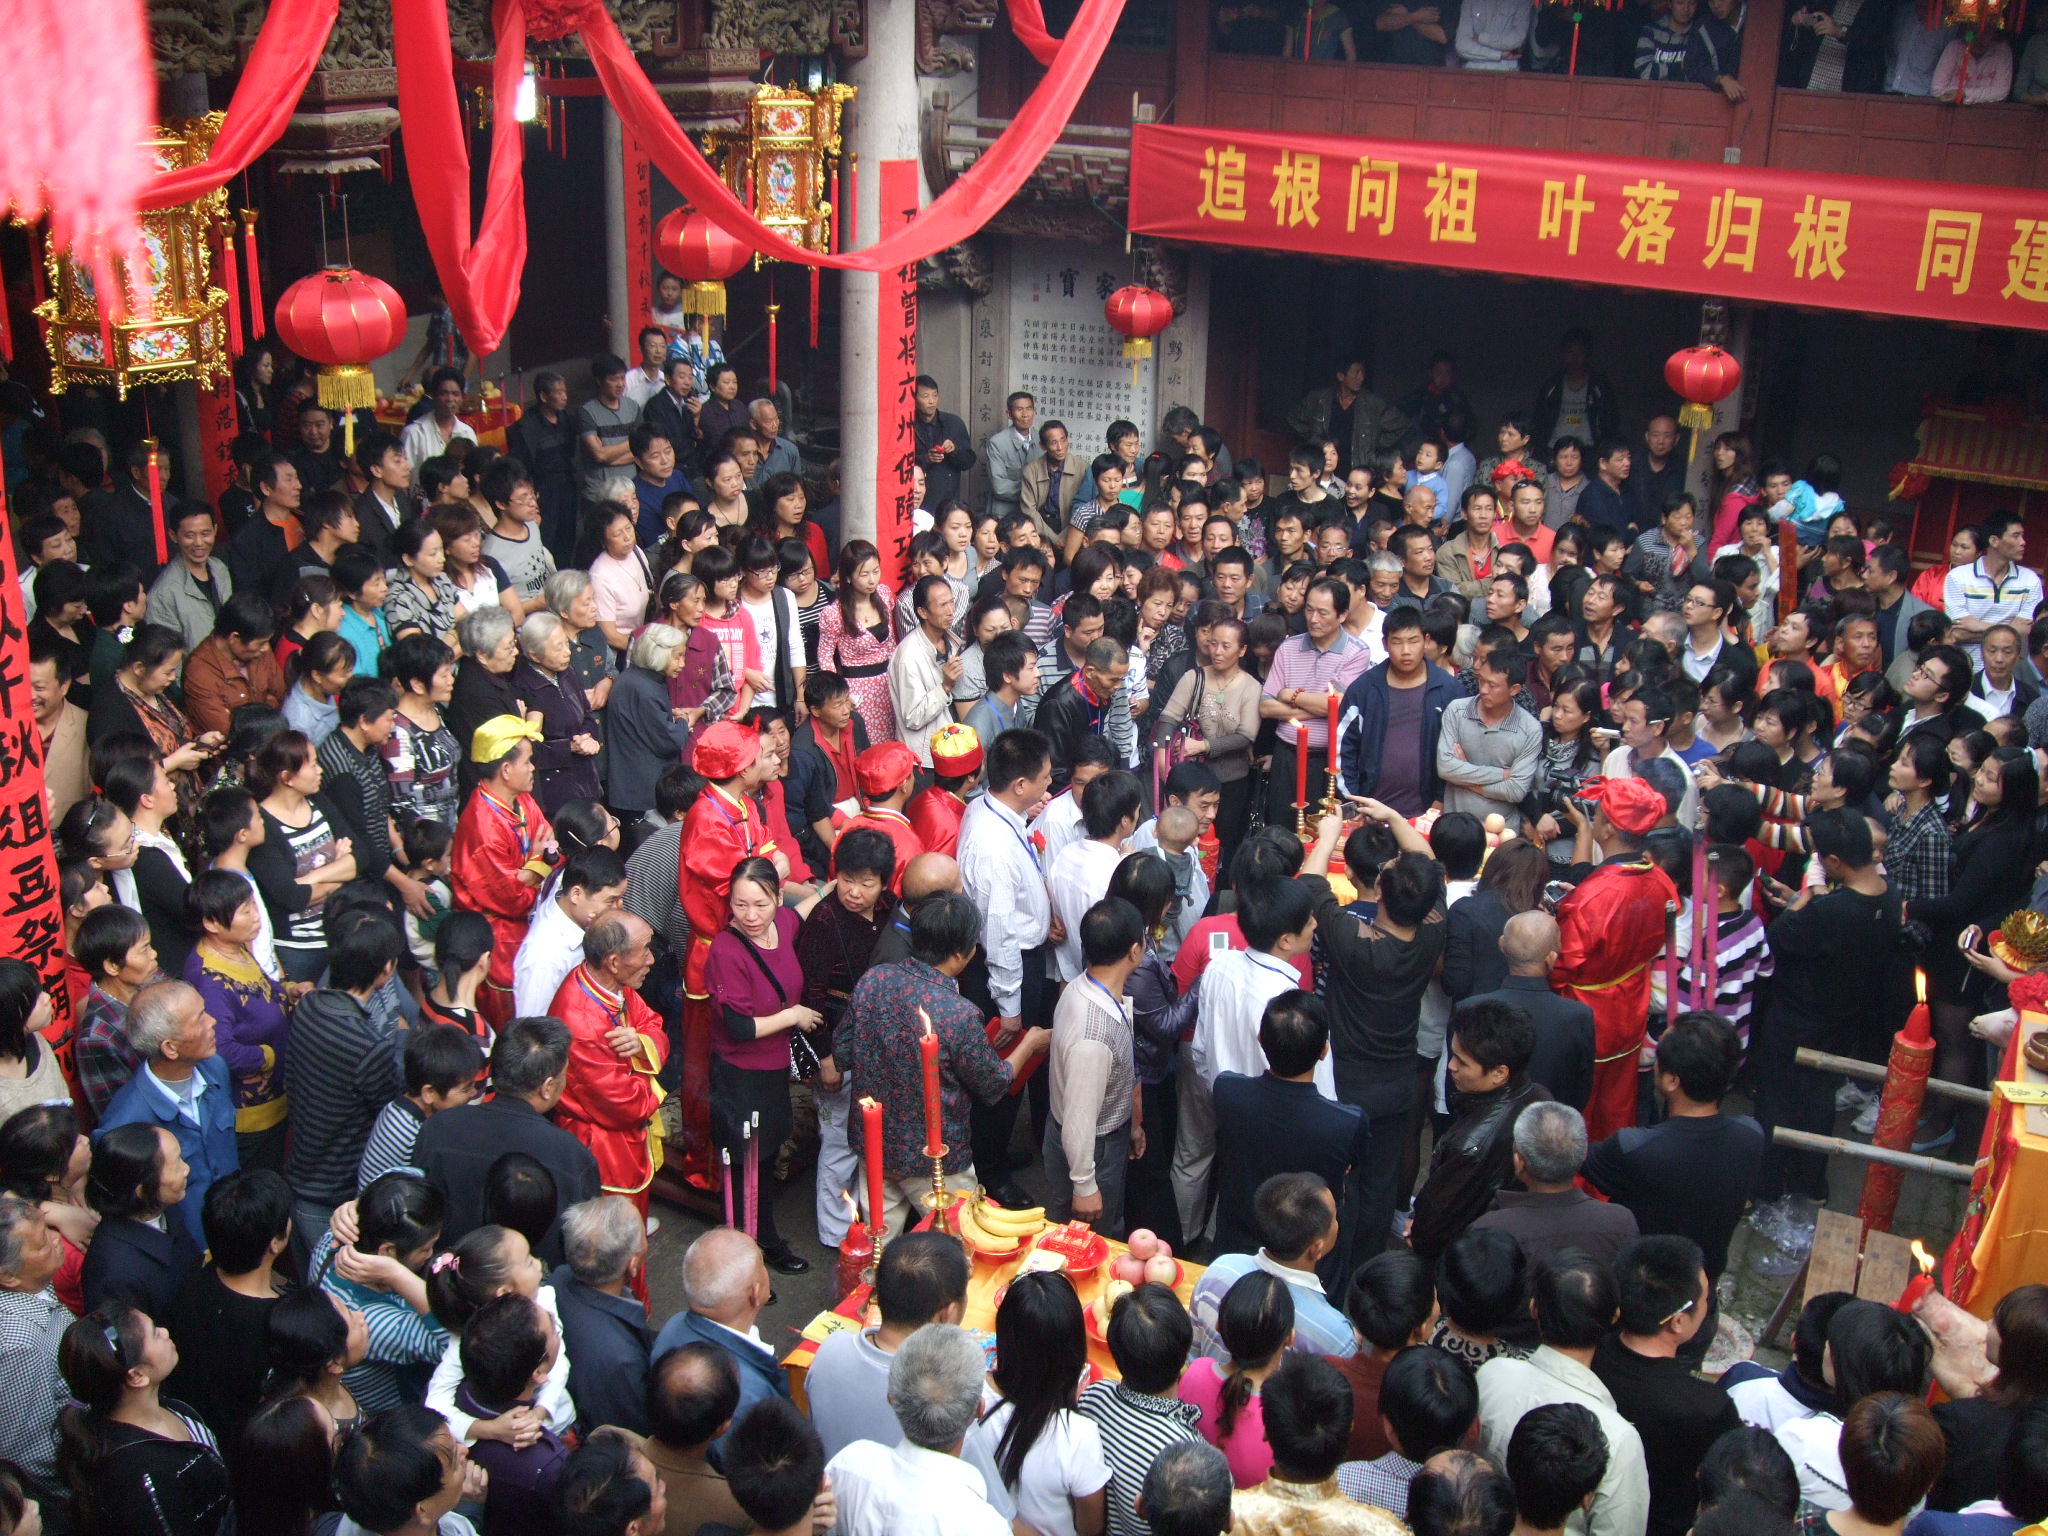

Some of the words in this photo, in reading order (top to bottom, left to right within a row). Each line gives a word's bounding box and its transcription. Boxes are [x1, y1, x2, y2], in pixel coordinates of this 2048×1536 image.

[1197, 144, 1478, 244] 追根问祖
[1538, 174, 1852, 281] 叶落归根
[1915, 208, 2048, 303] 同建
